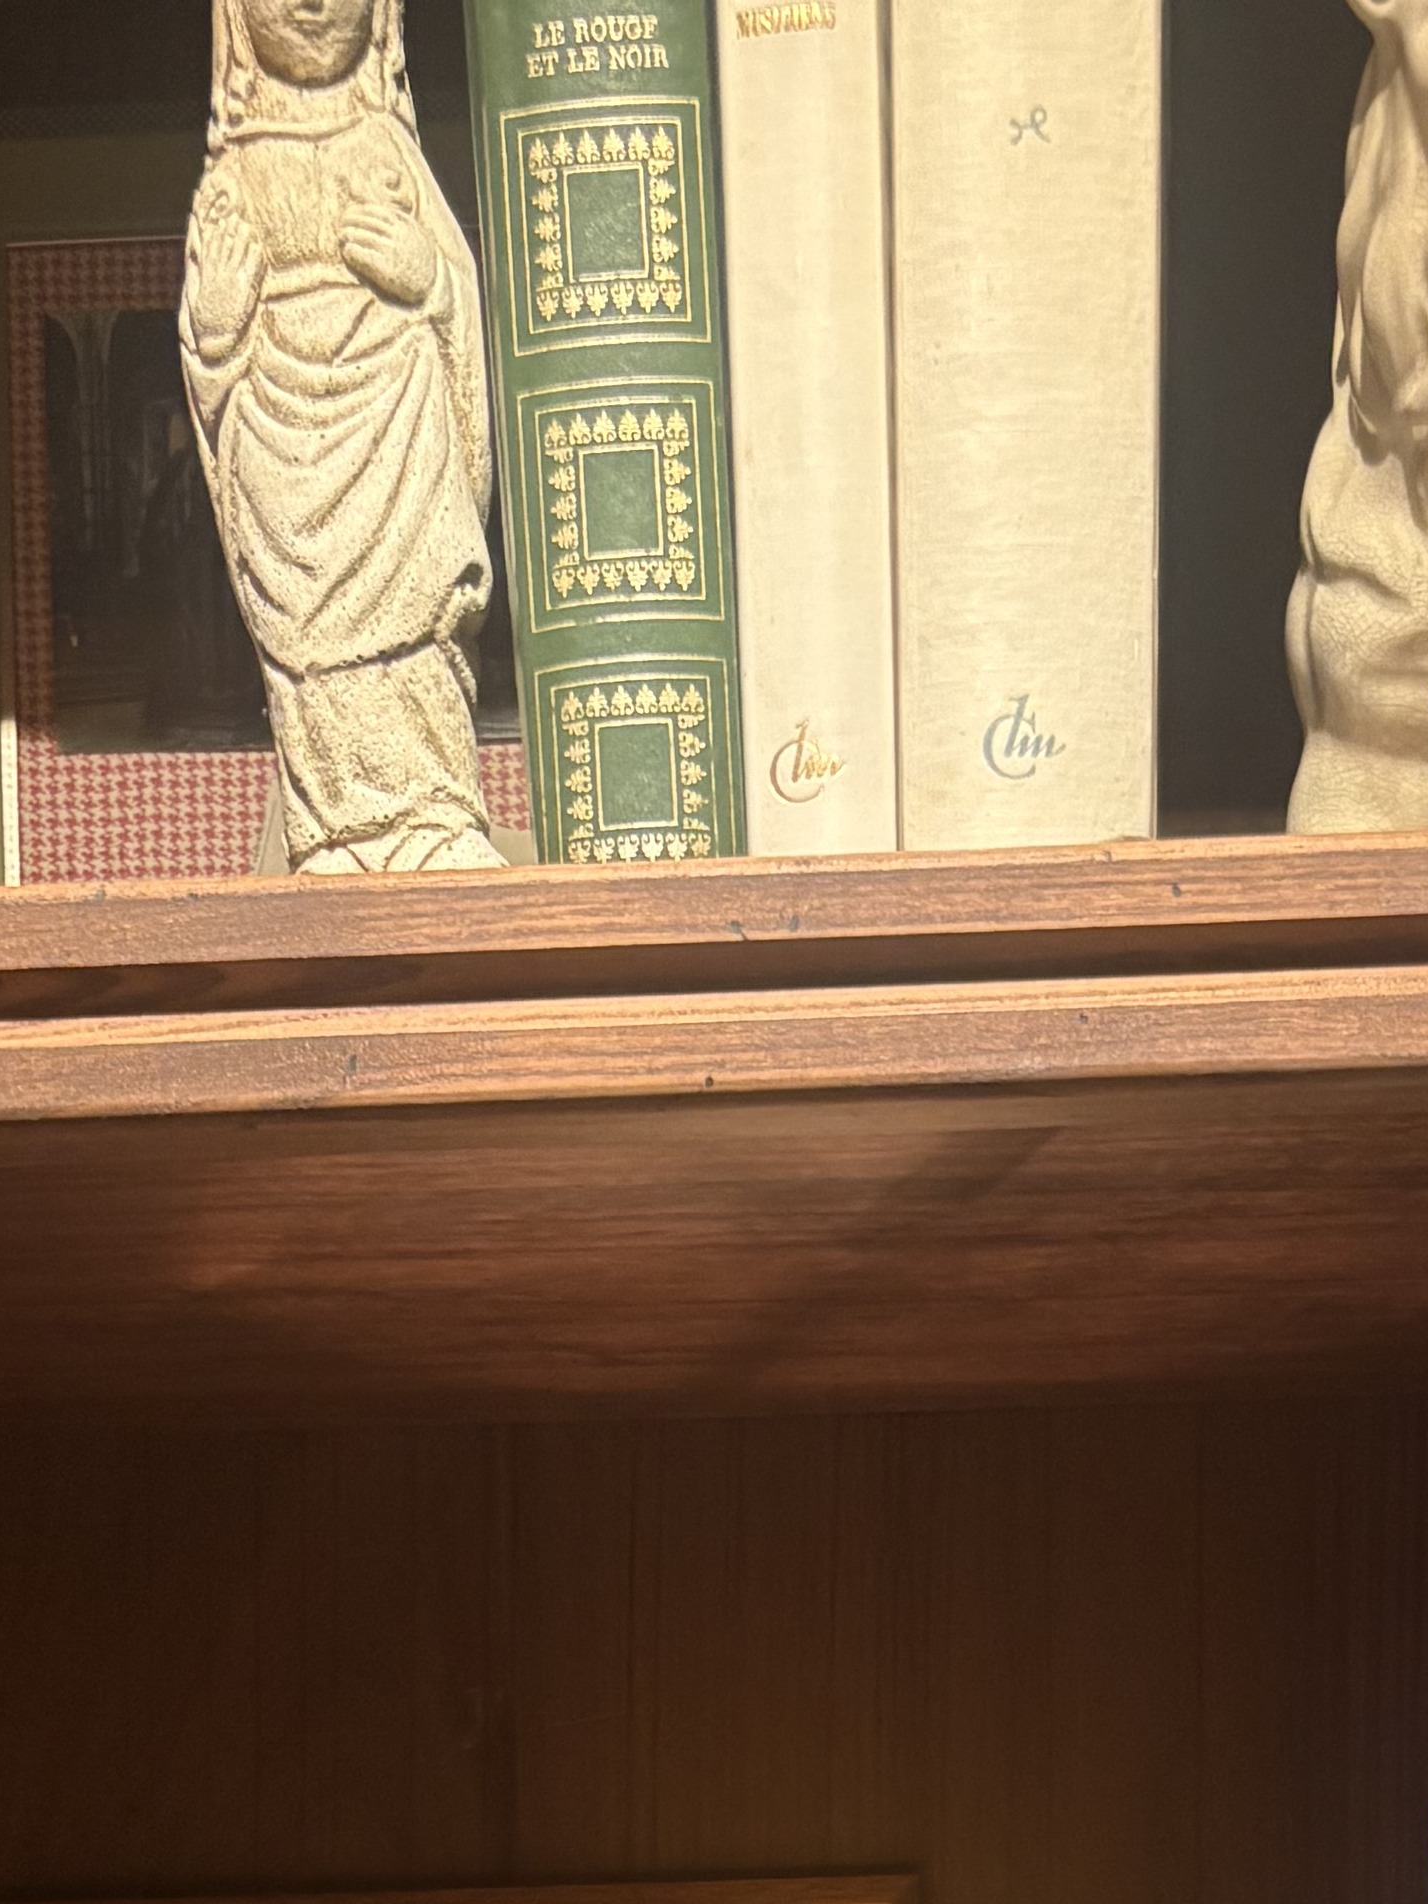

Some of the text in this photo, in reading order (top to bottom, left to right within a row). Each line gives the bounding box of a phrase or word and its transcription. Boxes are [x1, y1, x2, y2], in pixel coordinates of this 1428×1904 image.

[532, 15, 659, 49] LE ROUGE
[526, 43, 670, 78] ET LE NOIR
